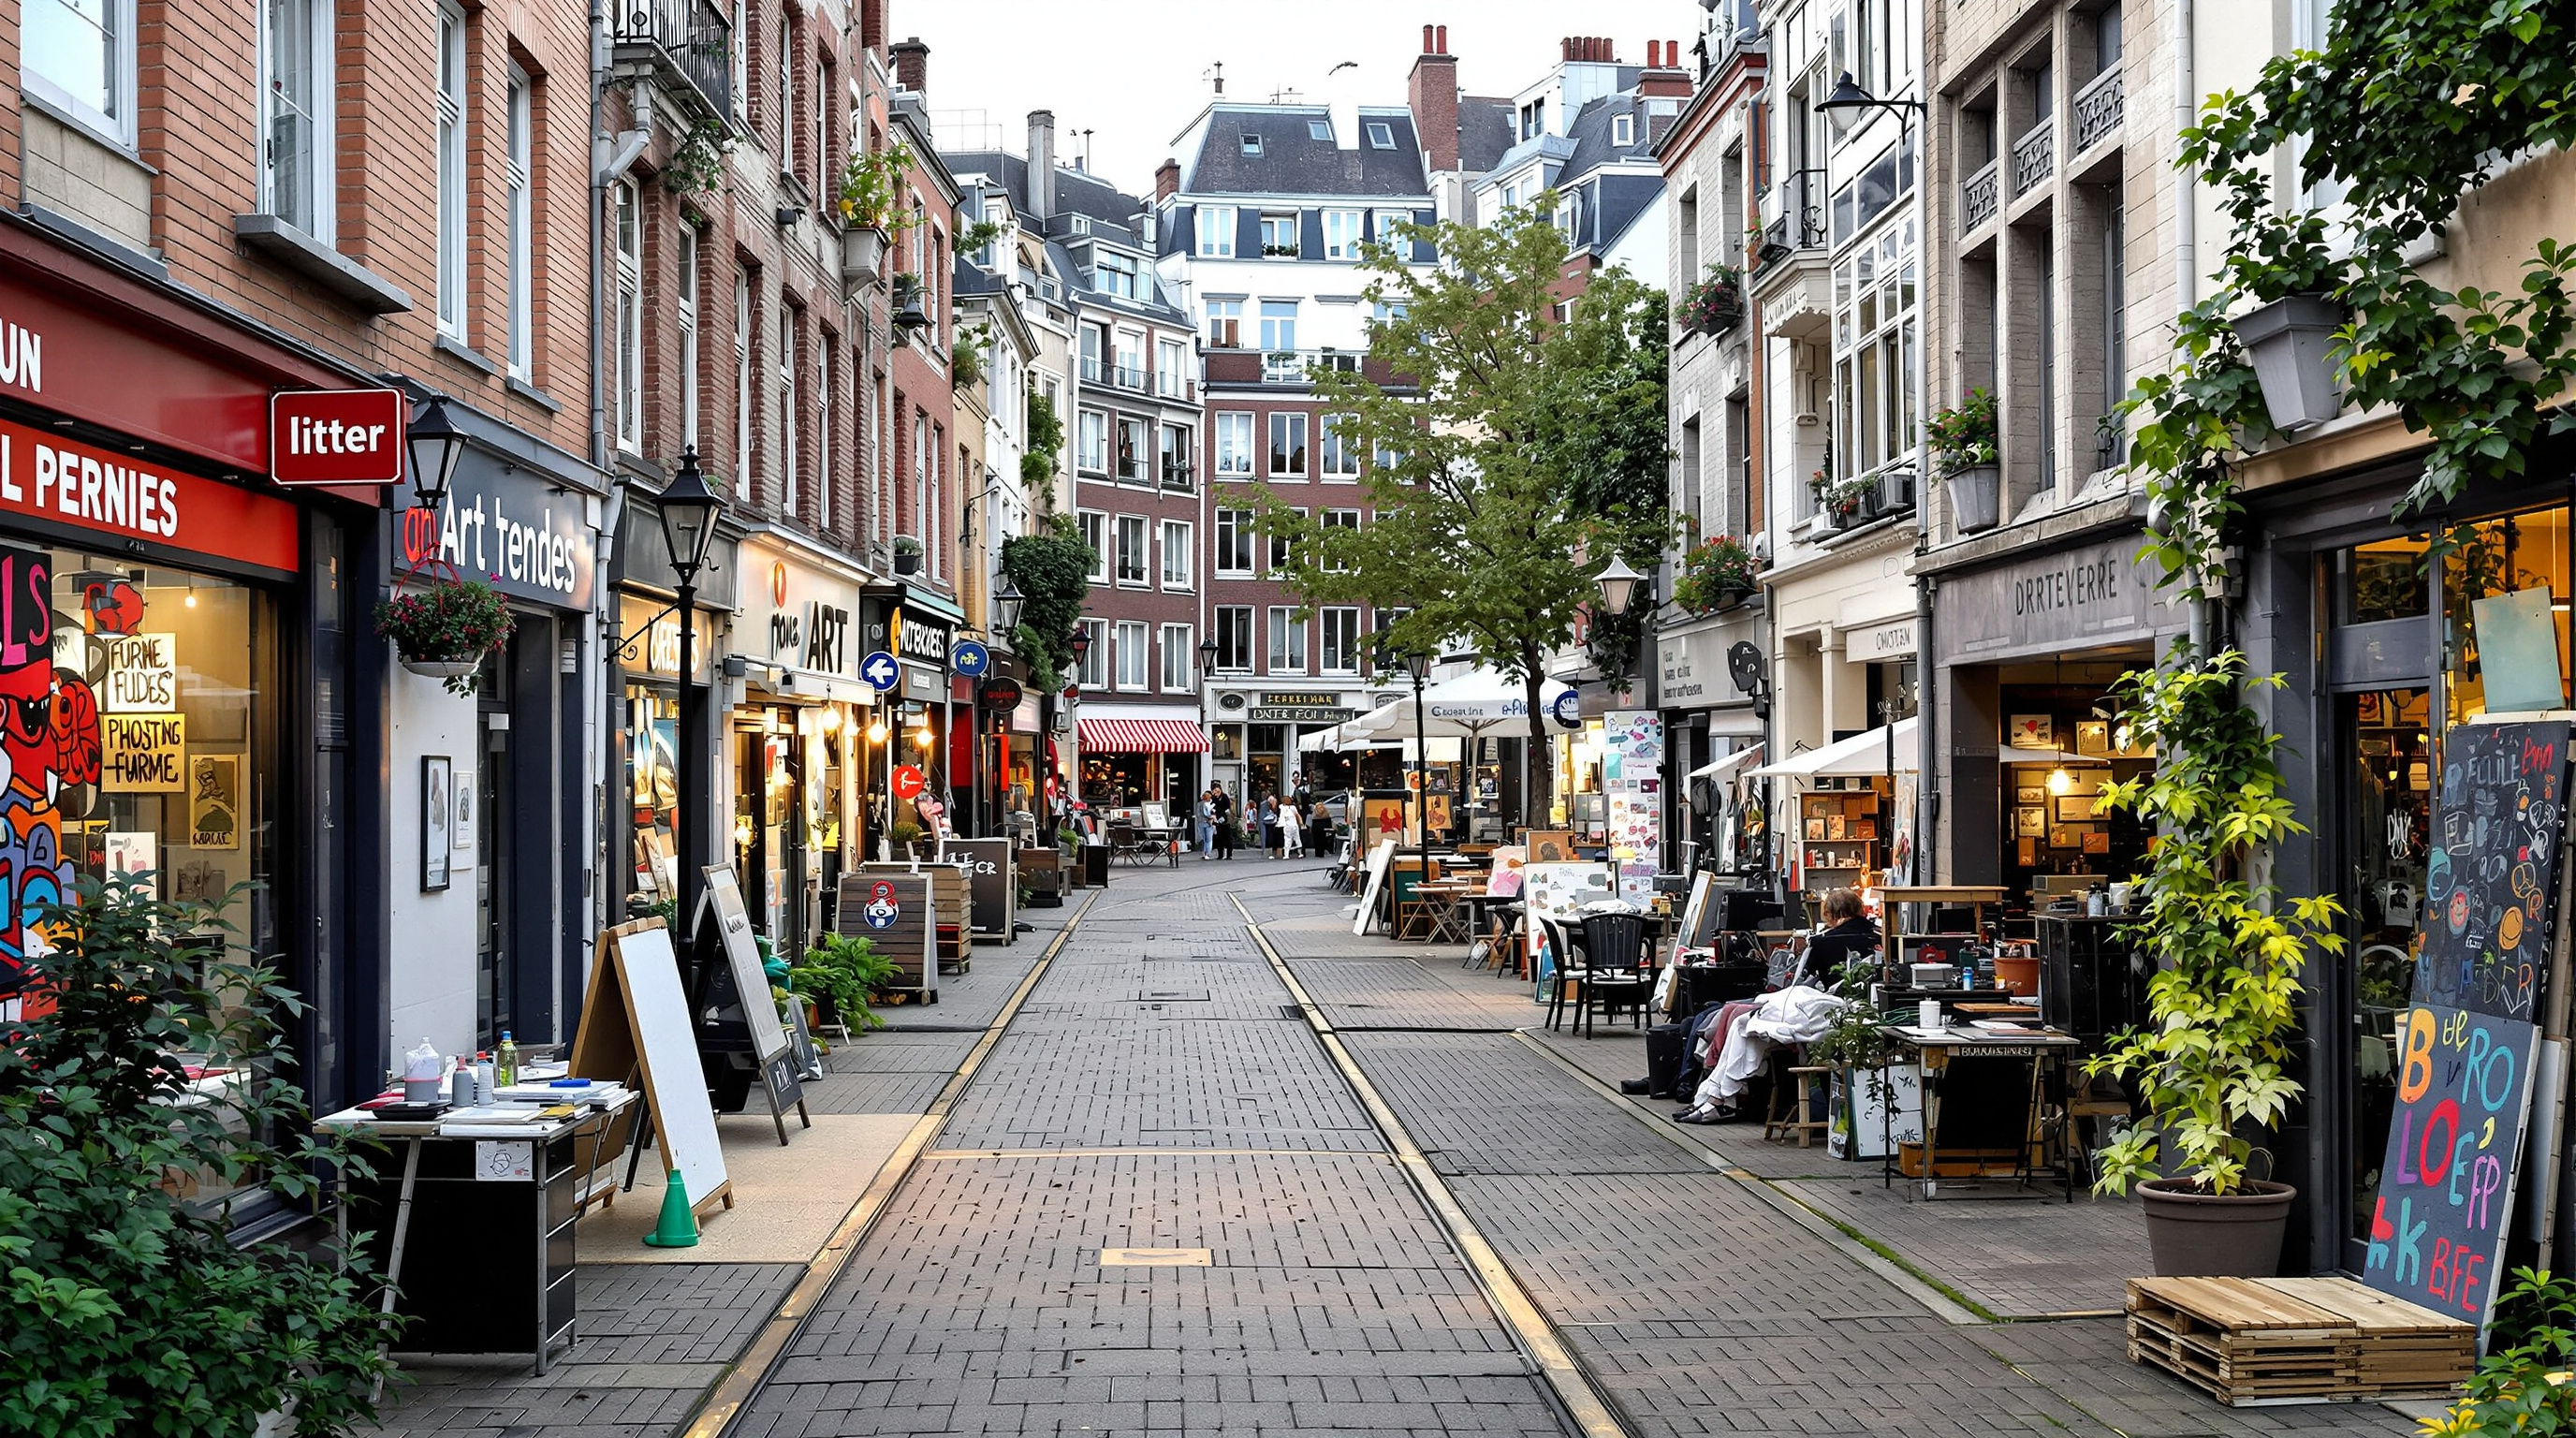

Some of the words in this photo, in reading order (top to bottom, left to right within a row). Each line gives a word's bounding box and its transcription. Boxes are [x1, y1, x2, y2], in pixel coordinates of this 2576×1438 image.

[290, 416, 386, 456] litter
[1, 433, 22, 503] L
[36, 443, 178, 538] PERNIES
[438, 484, 486, 572] Art
[806, 600, 848, 674] ART
